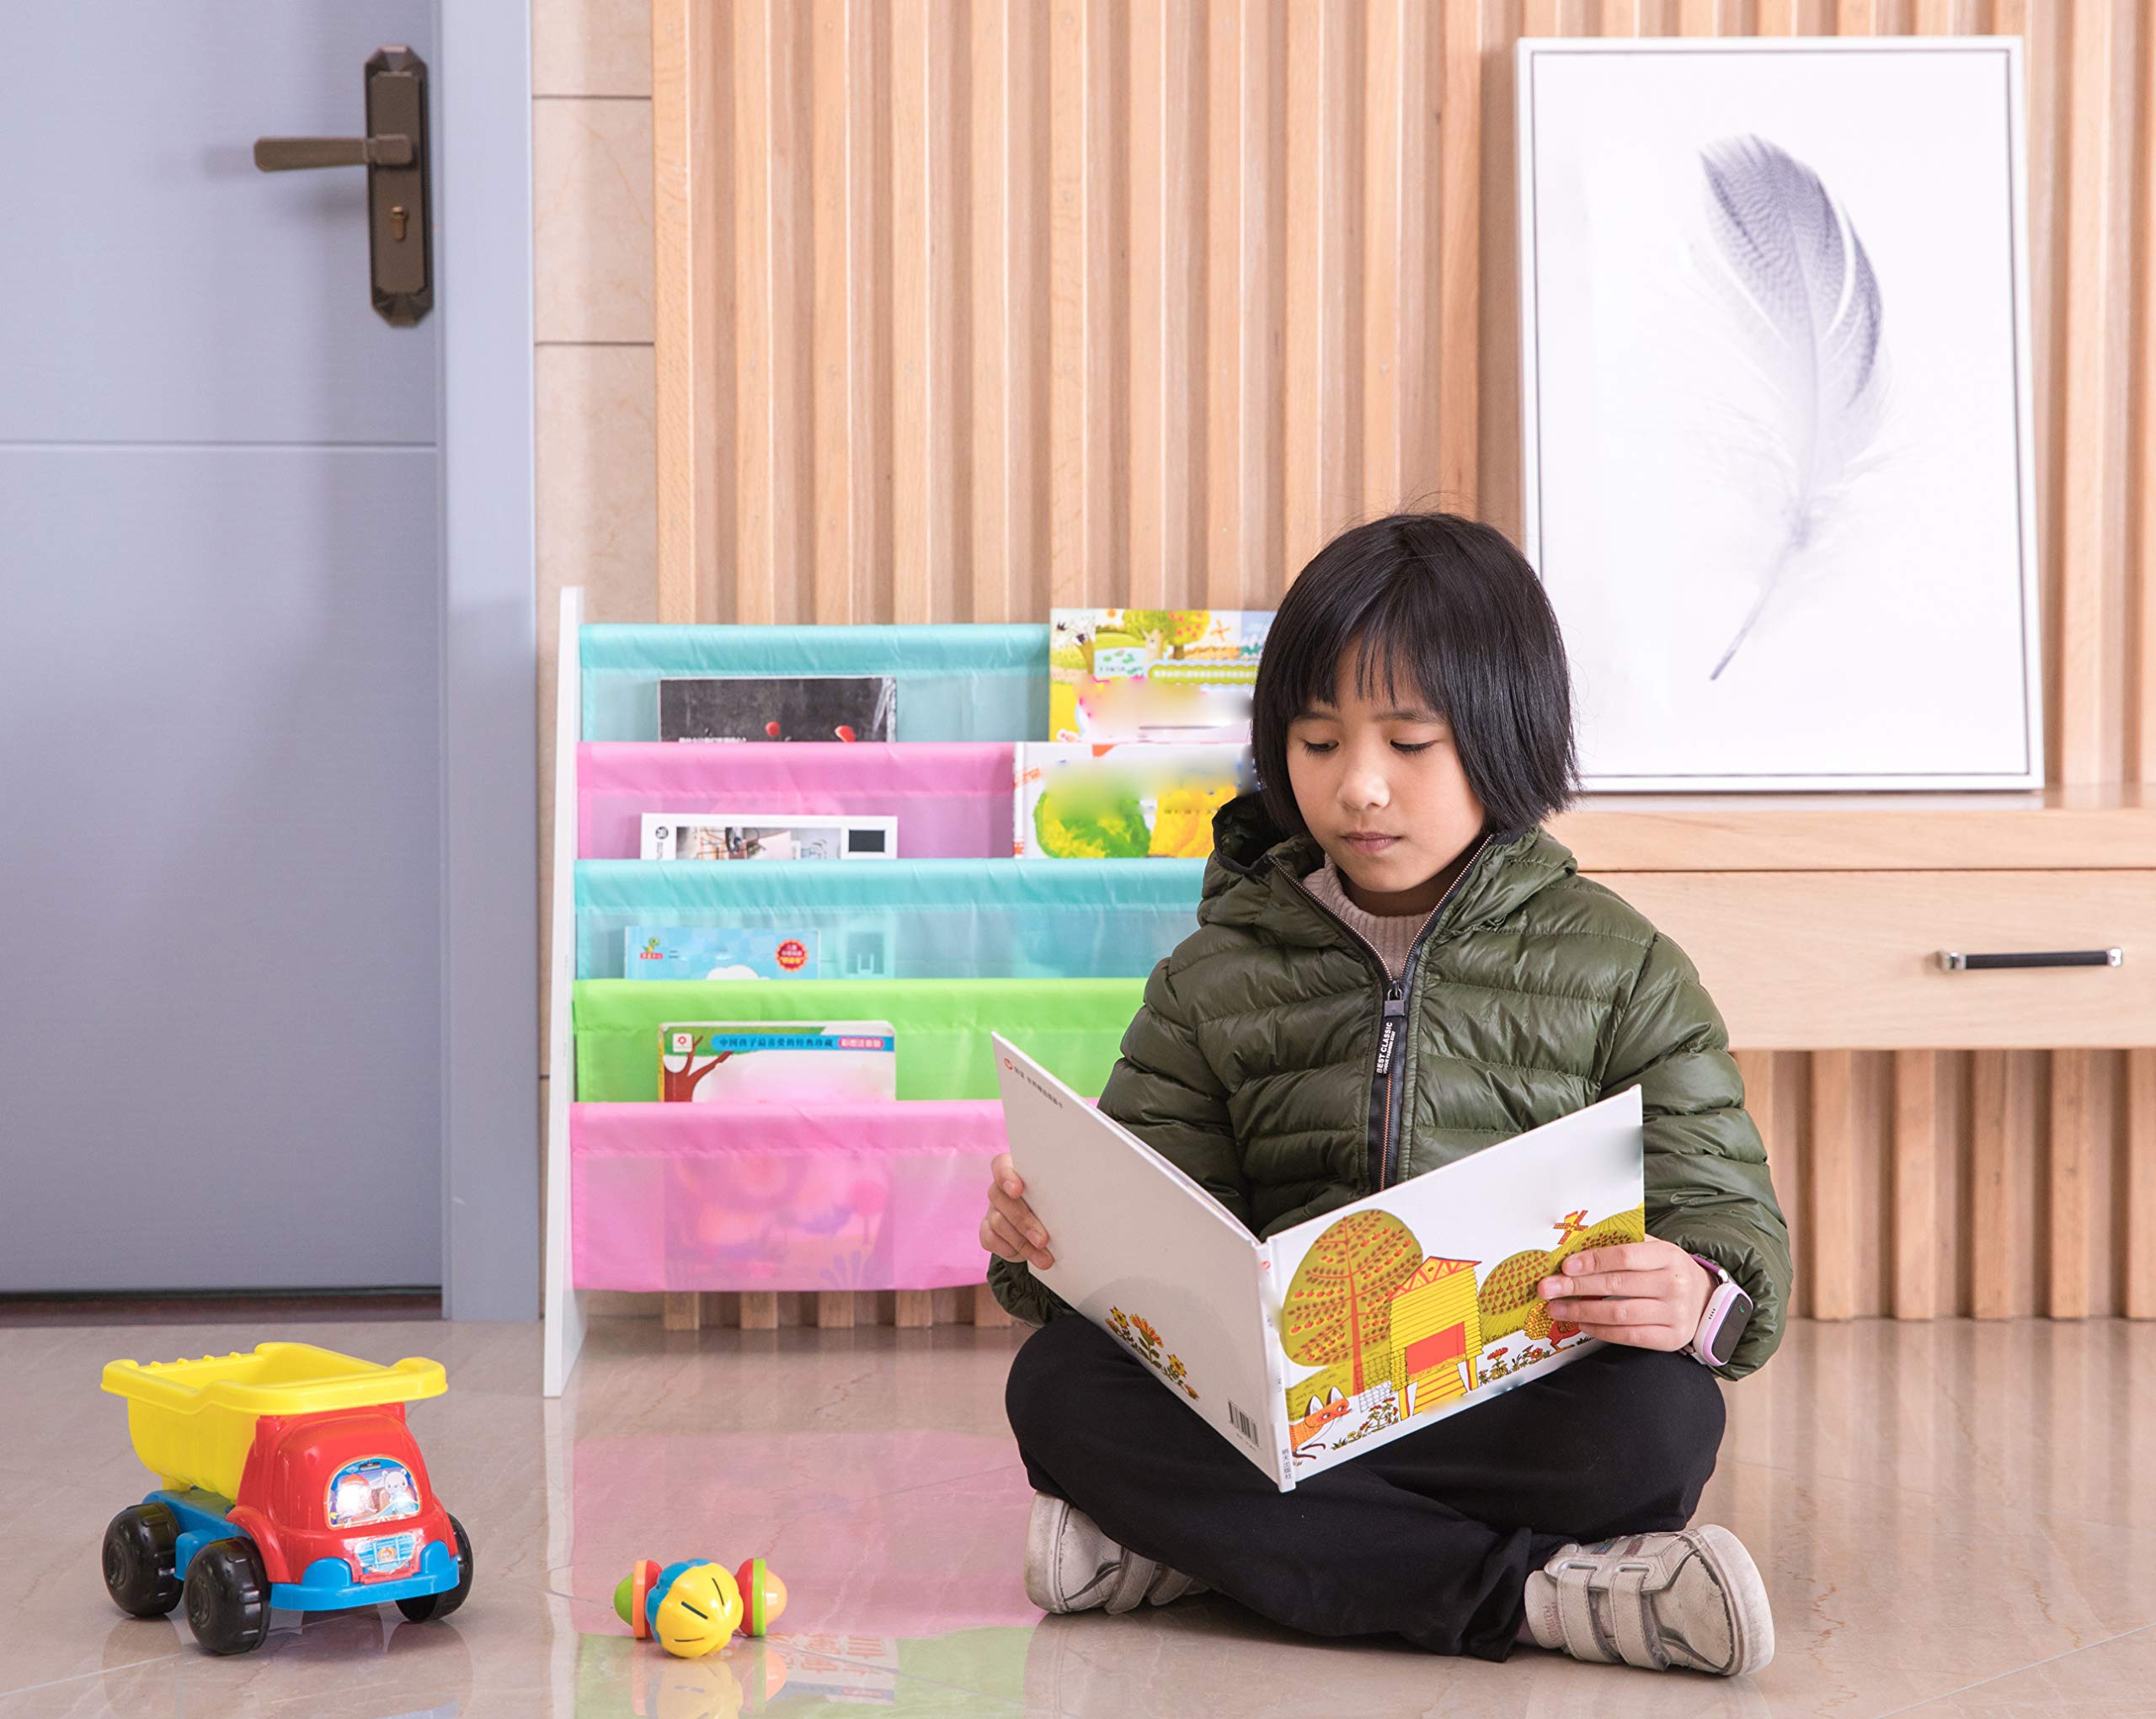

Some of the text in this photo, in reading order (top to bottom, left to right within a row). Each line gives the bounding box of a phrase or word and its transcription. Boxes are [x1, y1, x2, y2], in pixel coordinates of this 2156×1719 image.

[1376, 1022, 1393, 1073] BEST CLASSIC
[1282, 1449, 1292, 1480] 明天出版社
